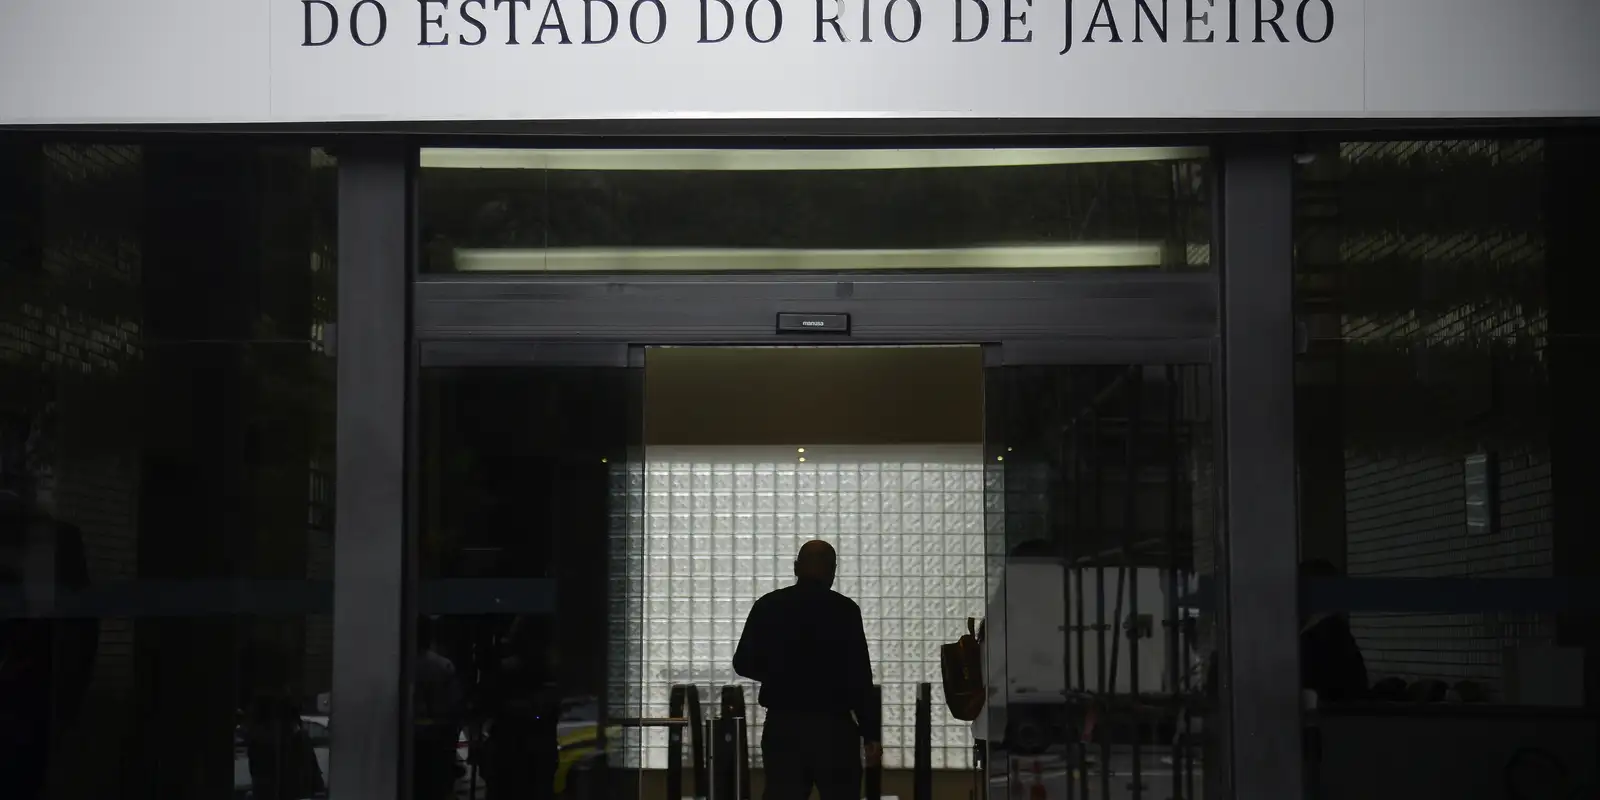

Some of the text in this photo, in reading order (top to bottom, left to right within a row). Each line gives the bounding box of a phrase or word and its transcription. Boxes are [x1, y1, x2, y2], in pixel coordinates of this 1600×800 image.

[301, 0, 1335, 56] DO ESTADO DO RIO DE JANEIRO
